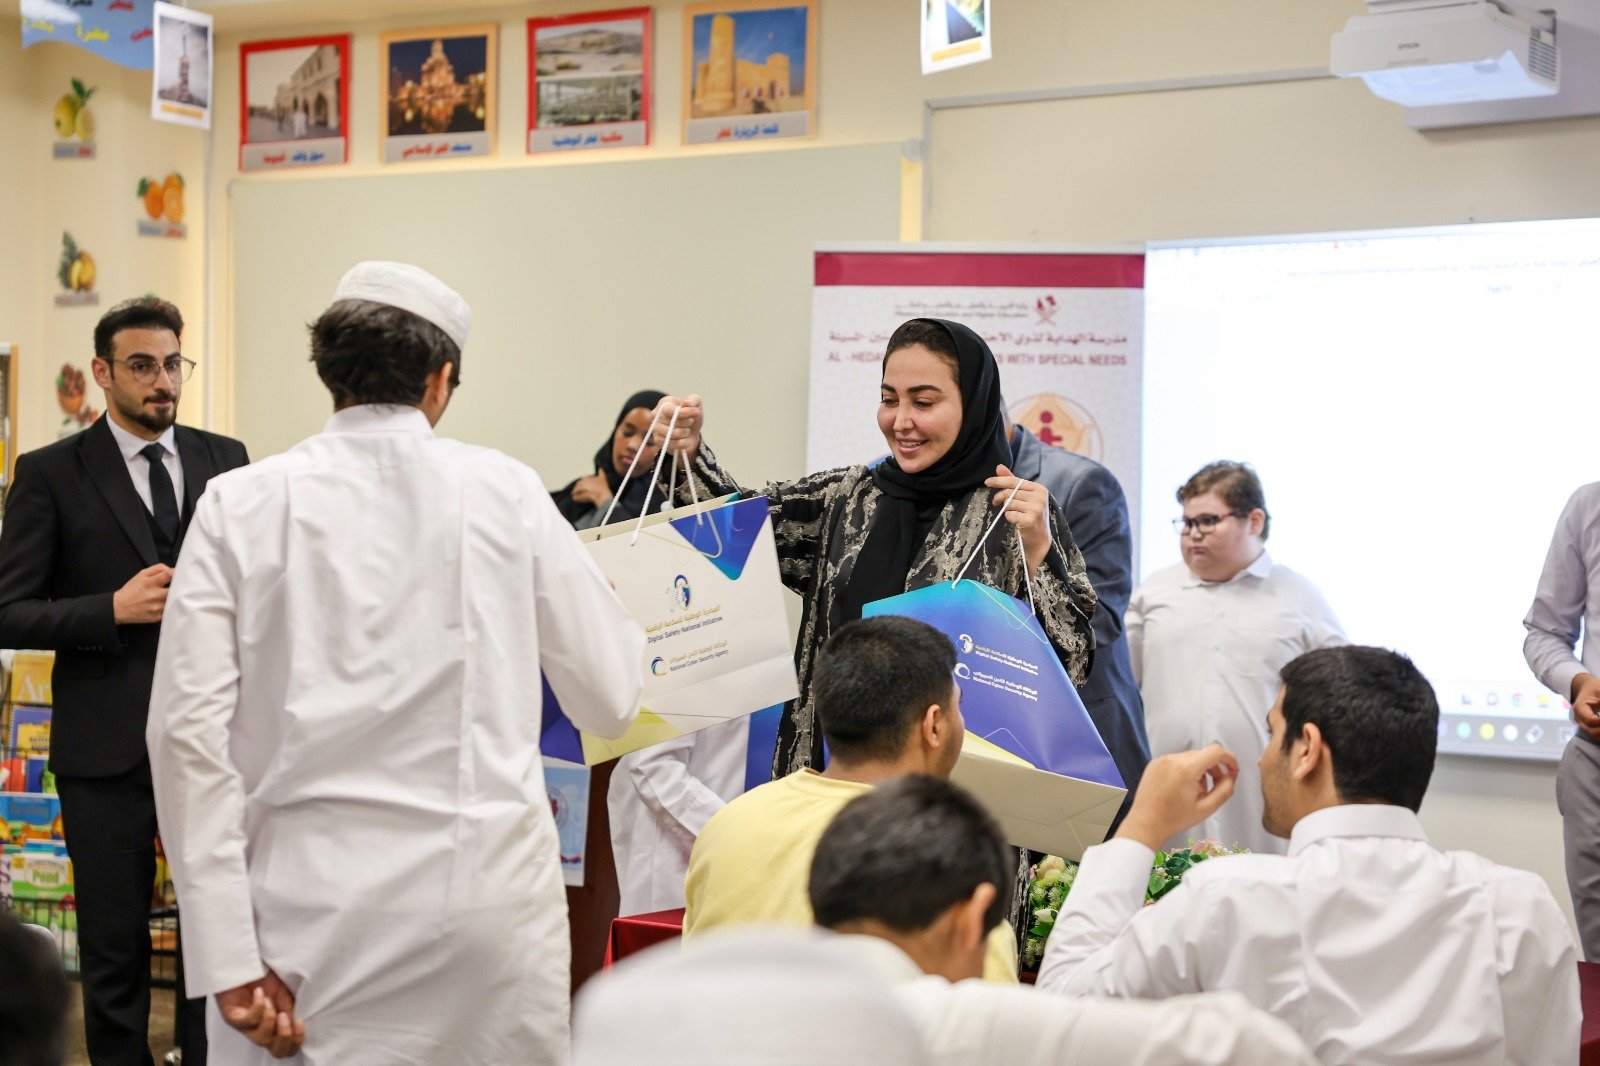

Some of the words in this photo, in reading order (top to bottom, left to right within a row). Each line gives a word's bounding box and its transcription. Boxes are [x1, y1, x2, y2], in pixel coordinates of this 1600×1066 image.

[1006, 352, 1035, 365] WITH
[1038, 352, 1085, 366] SPECIAL
[1088, 353, 1128, 366] NEEDS
[647, 633, 664, 644] Digital
[664, 628, 681, 639] Safety
[681, 622, 702, 633] National
[702, 615, 723, 627] Initiative
[17, 674, 50, 703] Ar
